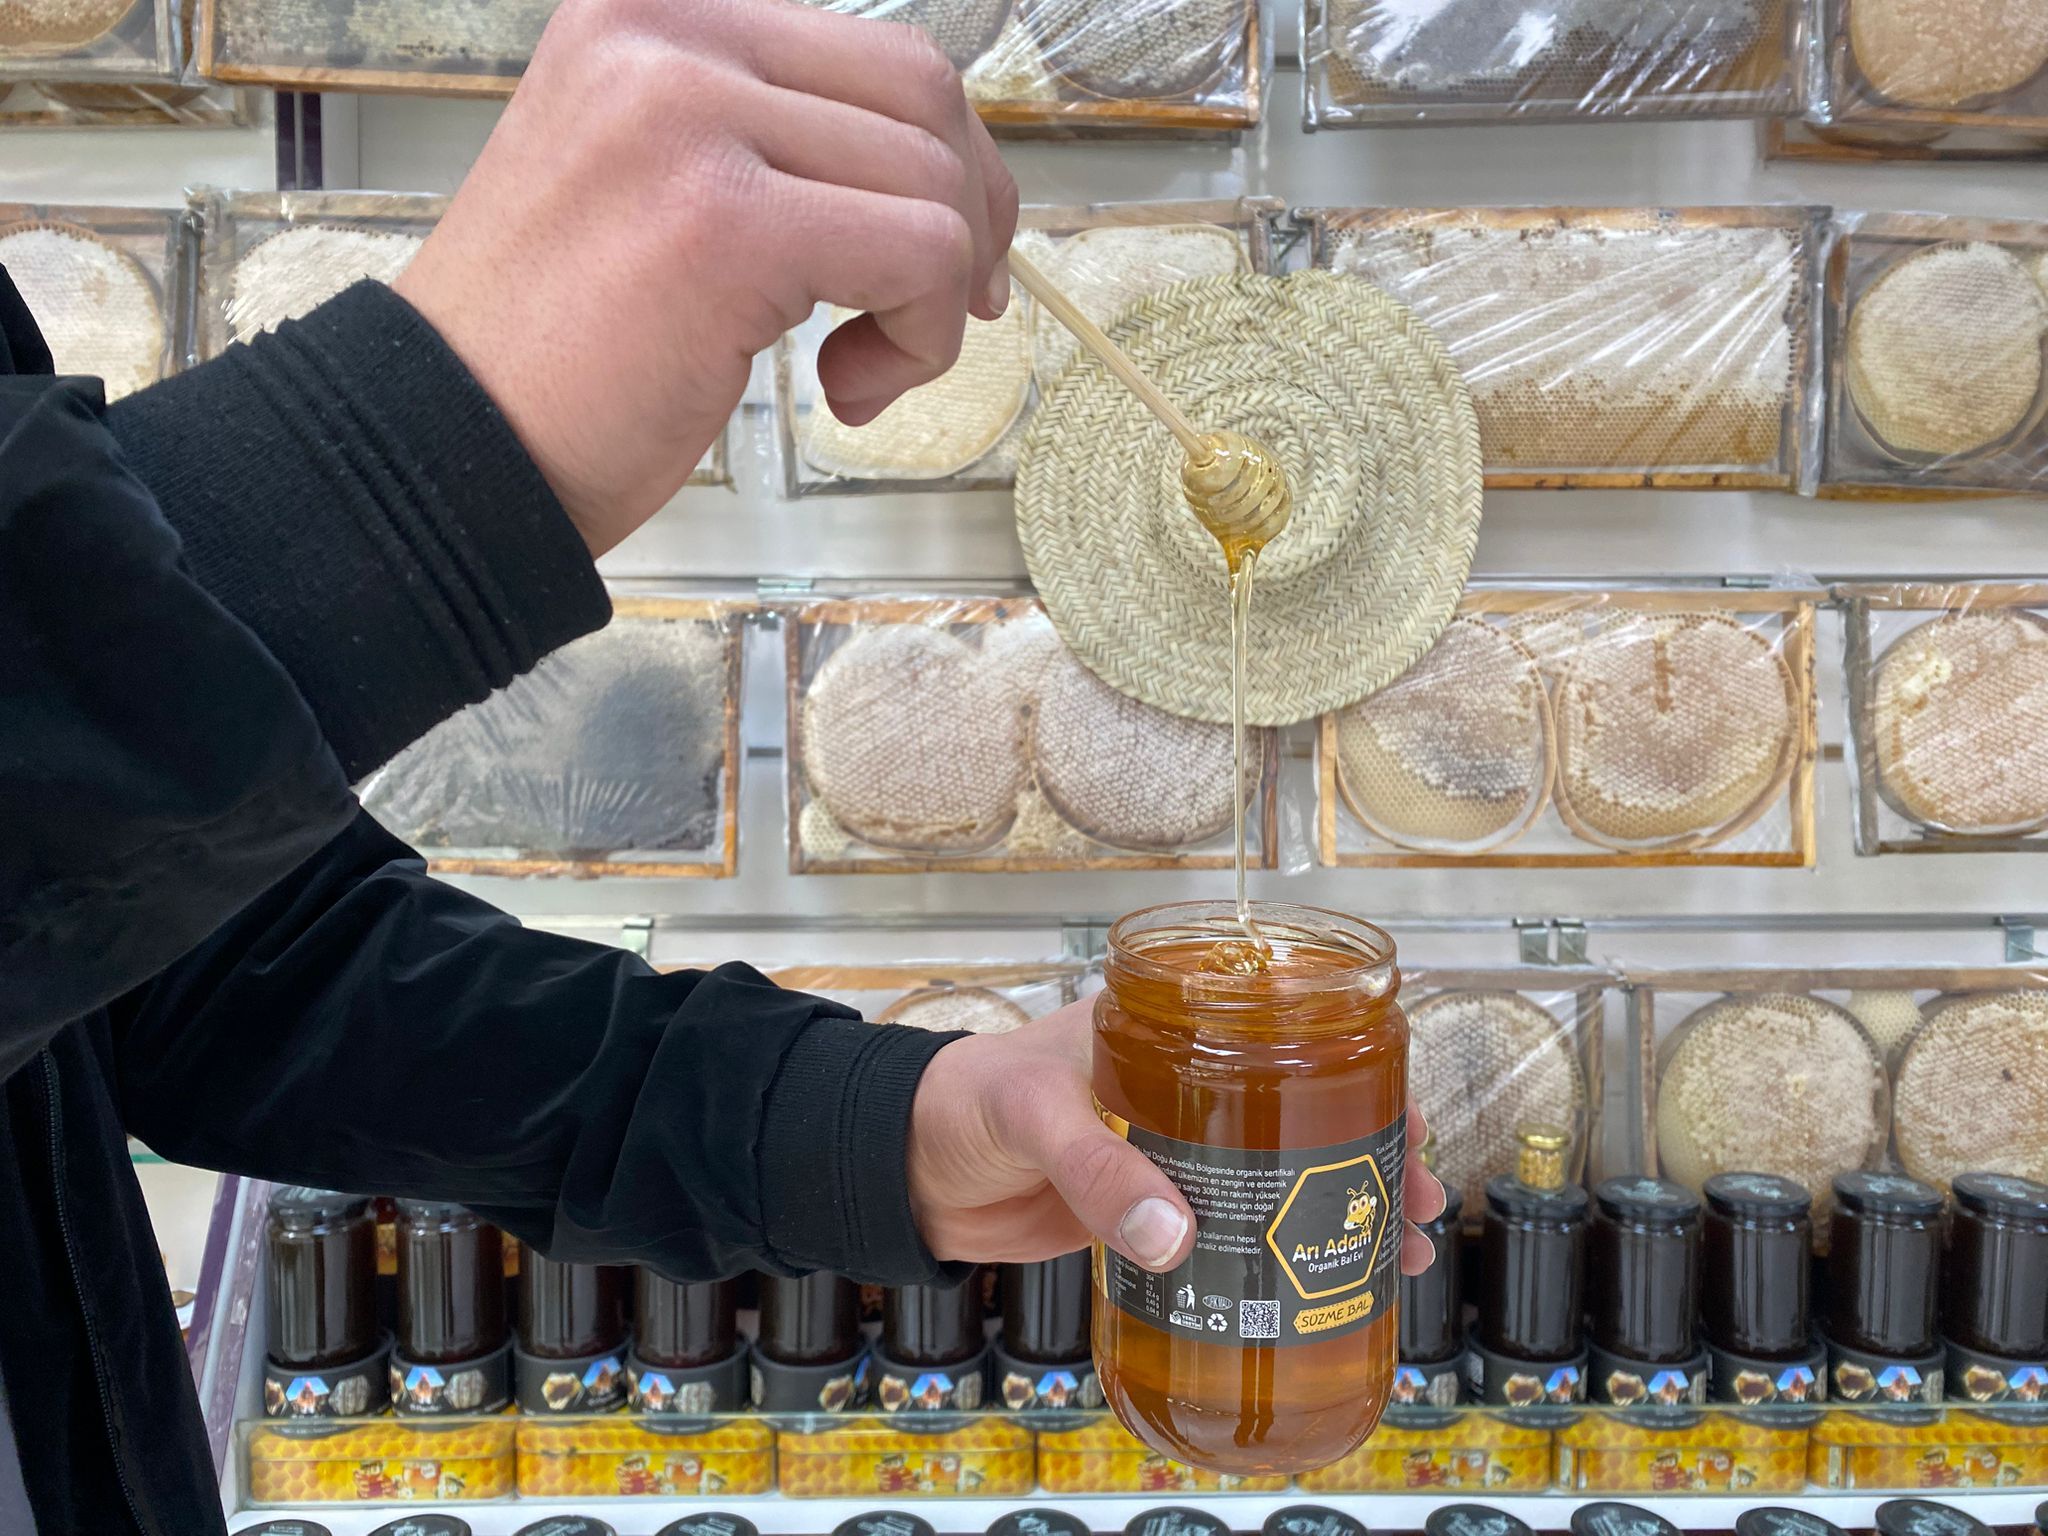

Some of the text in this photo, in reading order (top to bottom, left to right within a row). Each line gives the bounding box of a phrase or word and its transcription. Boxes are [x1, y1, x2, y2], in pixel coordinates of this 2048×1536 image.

[1152, 1151, 1168, 1164] Doğu
[1169, 1157, 1195, 1169] Anadolu
[1196, 1163, 1235, 1176] Bölgesinde
[1236, 1169, 1263, 1178] organik
[1264, 1167, 1296, 1177] sertifikalı
[1178, 1170, 1209, 1184] ülkemizin
[1210, 1178, 1220, 1186] en
[1221, 1179, 1245, 1189] zengin
[1246, 1180, 1255, 1188] ve
[1256, 1179, 1287, 1189] endemik
[1182, 1184, 1201, 1195] sahip
[1202, 1186, 1220, 1197] 3000
[1221, 1190, 1229, 1198] m
[1230, 1190, 1254, 1199] rakımlı
[1255, 1191, 1281, 1202] yüksek
[1189, 1195, 1210, 1206] Adam
[1210, 1199, 1239, 1210] markası
[1240, 1201, 1253, 1212] için
[1254, 1202, 1274, 1213] doğal
[1197, 1241, 1217, 1250] analiz
[1236, 1234, 1257, 1245] hepsi
[1292, 1243, 1320, 1262] Arı
[1324, 1229, 1372, 1258] Adam
[1308, 1258, 1340, 1273] Organik
[1340, 1252, 1353, 1266] Bal
[1347, 1299, 1369, 1317] BAL
